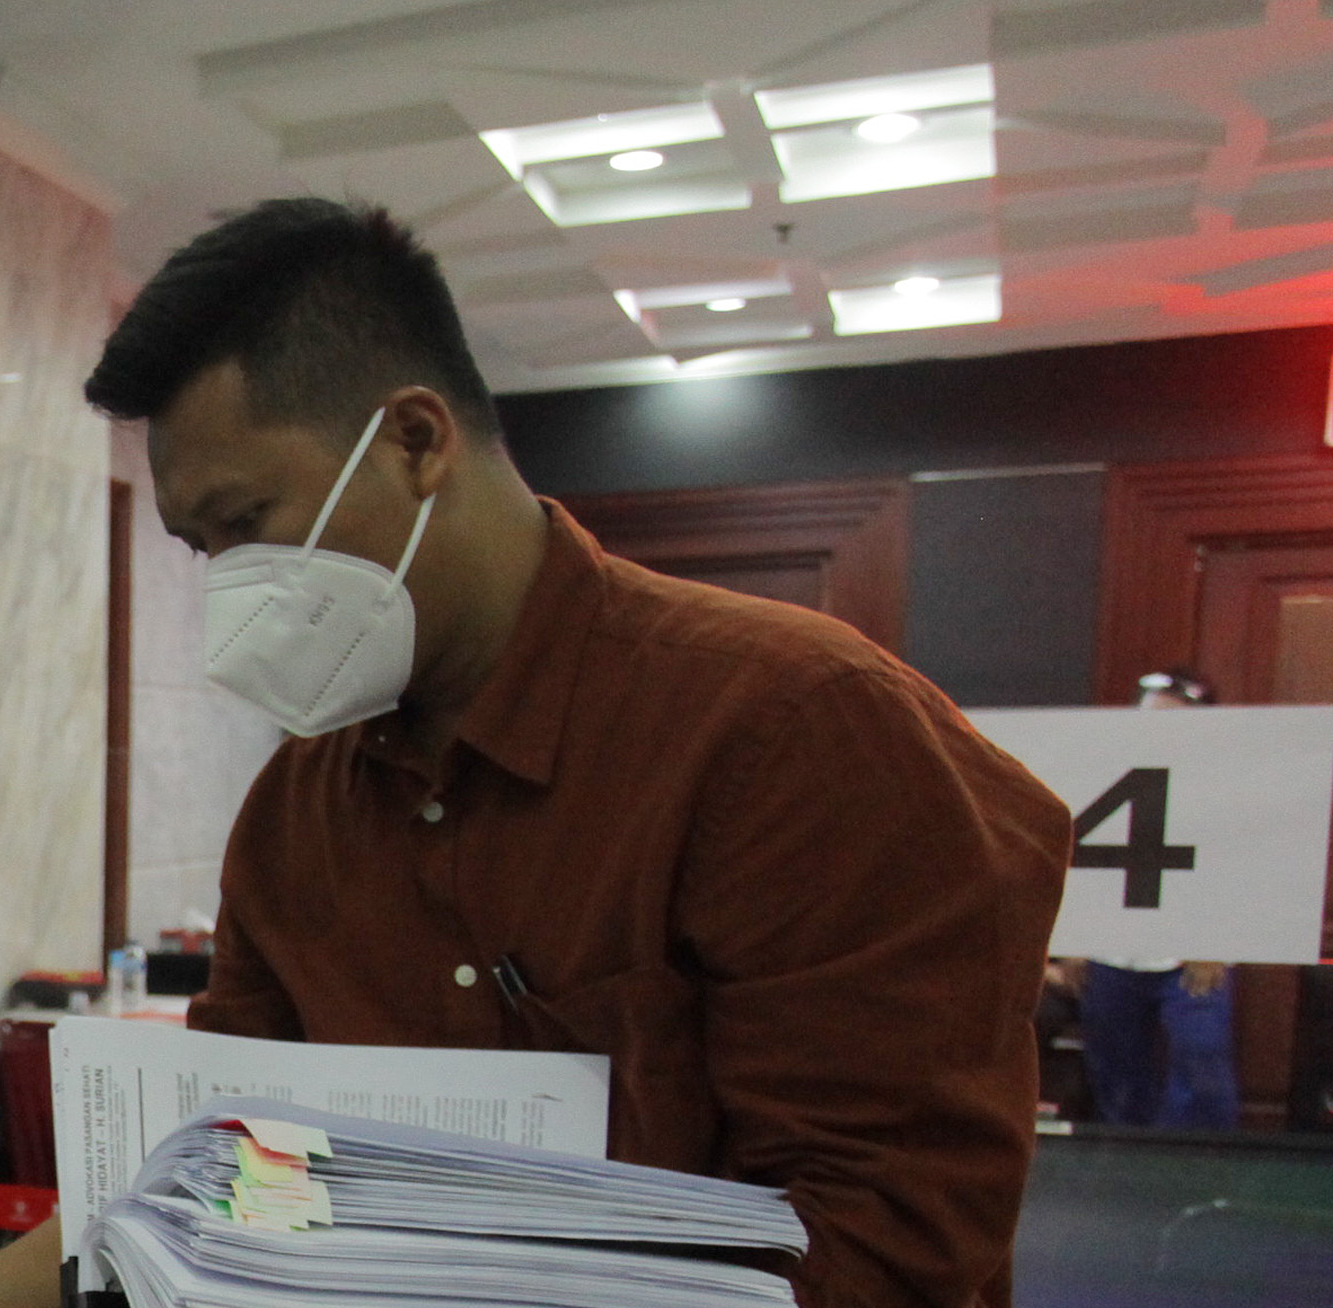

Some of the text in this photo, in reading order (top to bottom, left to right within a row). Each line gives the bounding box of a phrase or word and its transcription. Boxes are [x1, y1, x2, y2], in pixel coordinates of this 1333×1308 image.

[1070, 768, 1196, 909] 4
[95, 1068, 106, 1111] SURIAN
[83, 1101, 94, 1154] PASANGAN
[84, 1156, 95, 1205] ADVOKASI
[96, 1140, 108, 1191] HIDAYAT
